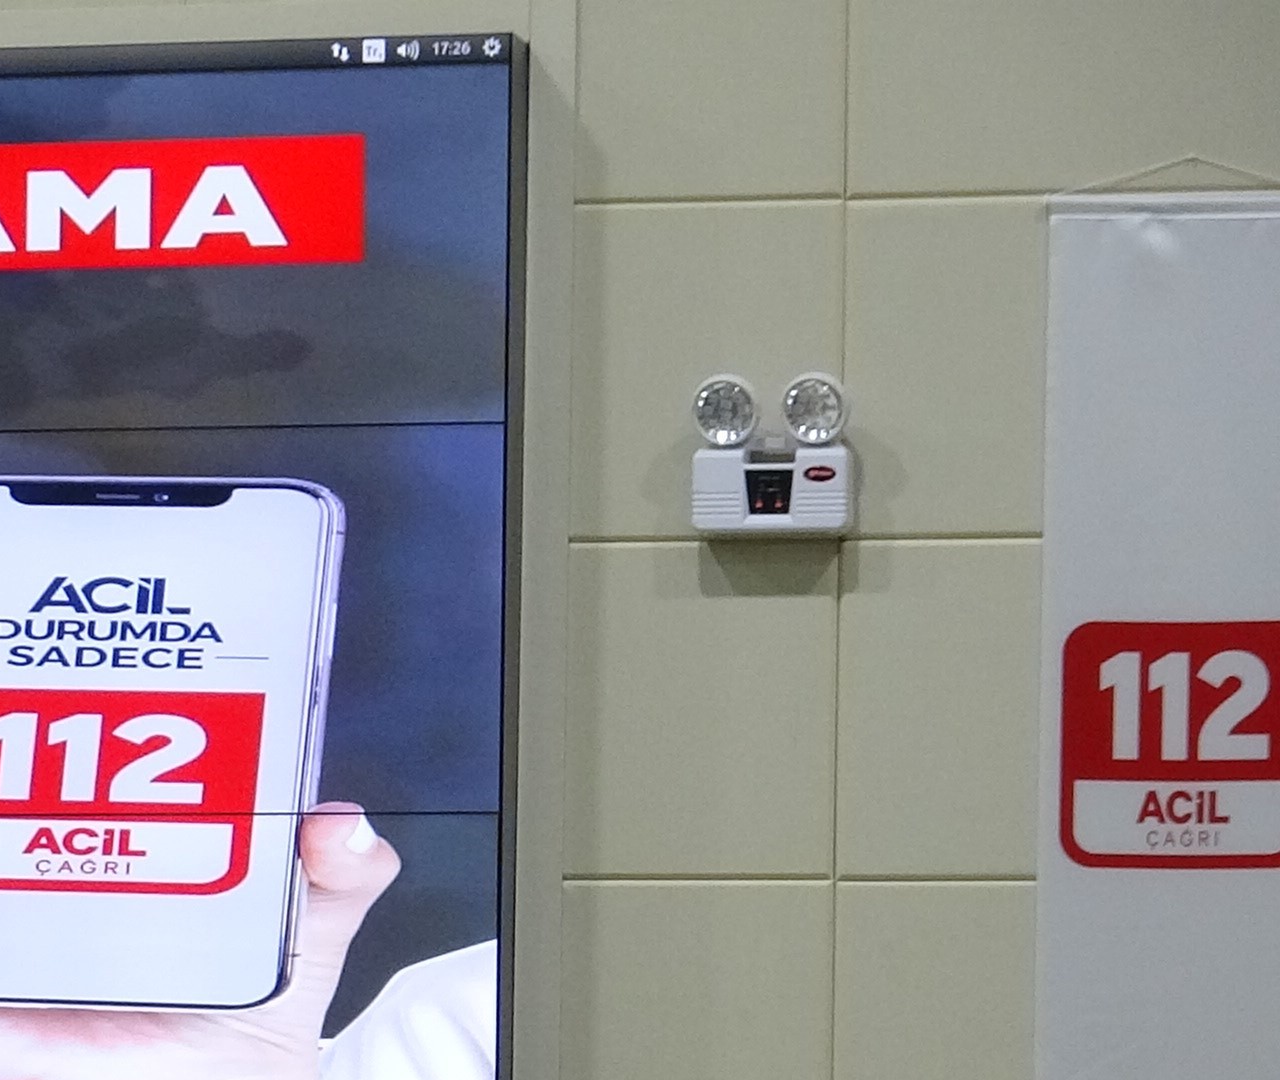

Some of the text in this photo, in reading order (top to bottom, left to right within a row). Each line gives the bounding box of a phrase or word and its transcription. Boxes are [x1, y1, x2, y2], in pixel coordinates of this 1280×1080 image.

[432, 40, 471, 55] 17:26
[7, 646, 204, 670] SADECE
[1099, 650, 1270, 761] 112
[1146, 828, 1221, 849] ÇAĞRI
[35, 859, 130, 876] ÇAĞRI
